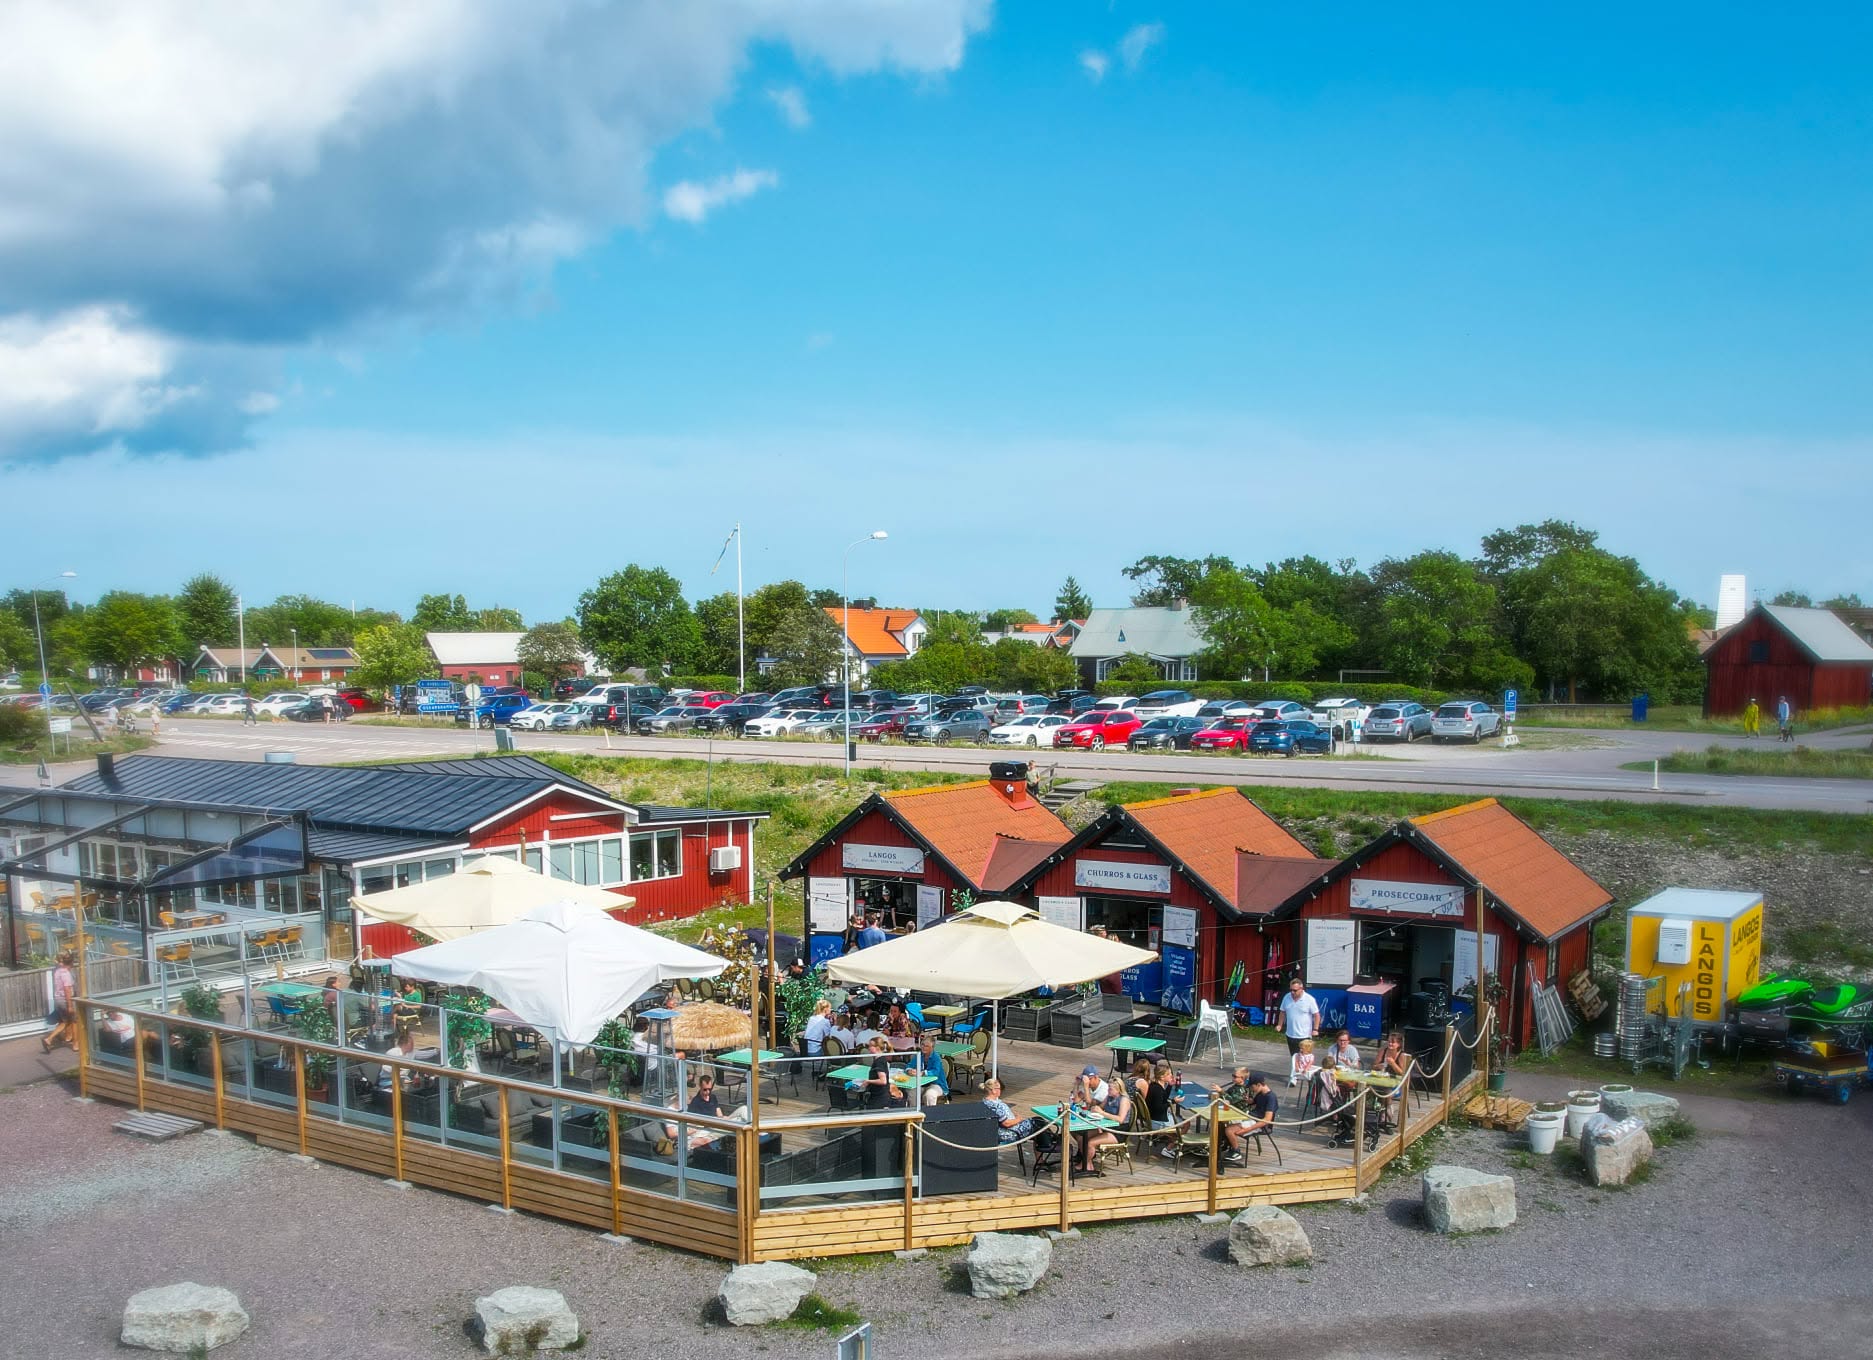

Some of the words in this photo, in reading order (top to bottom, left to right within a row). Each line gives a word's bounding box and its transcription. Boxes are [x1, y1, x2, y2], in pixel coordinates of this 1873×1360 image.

[1508, 692, 1514, 700] P
[868, 852, 897, 860] LANGOS
[1087, 870, 1124, 878] CHURROS
[1133, 873, 1158, 881] GLASS
[1371, 890, 1442, 902] PROSECCOBAR
[1733, 915, 1759, 947] LANGOS
[1695, 927, 1714, 1015] LANGOS
[1354, 1003, 1375, 1013] BAR
